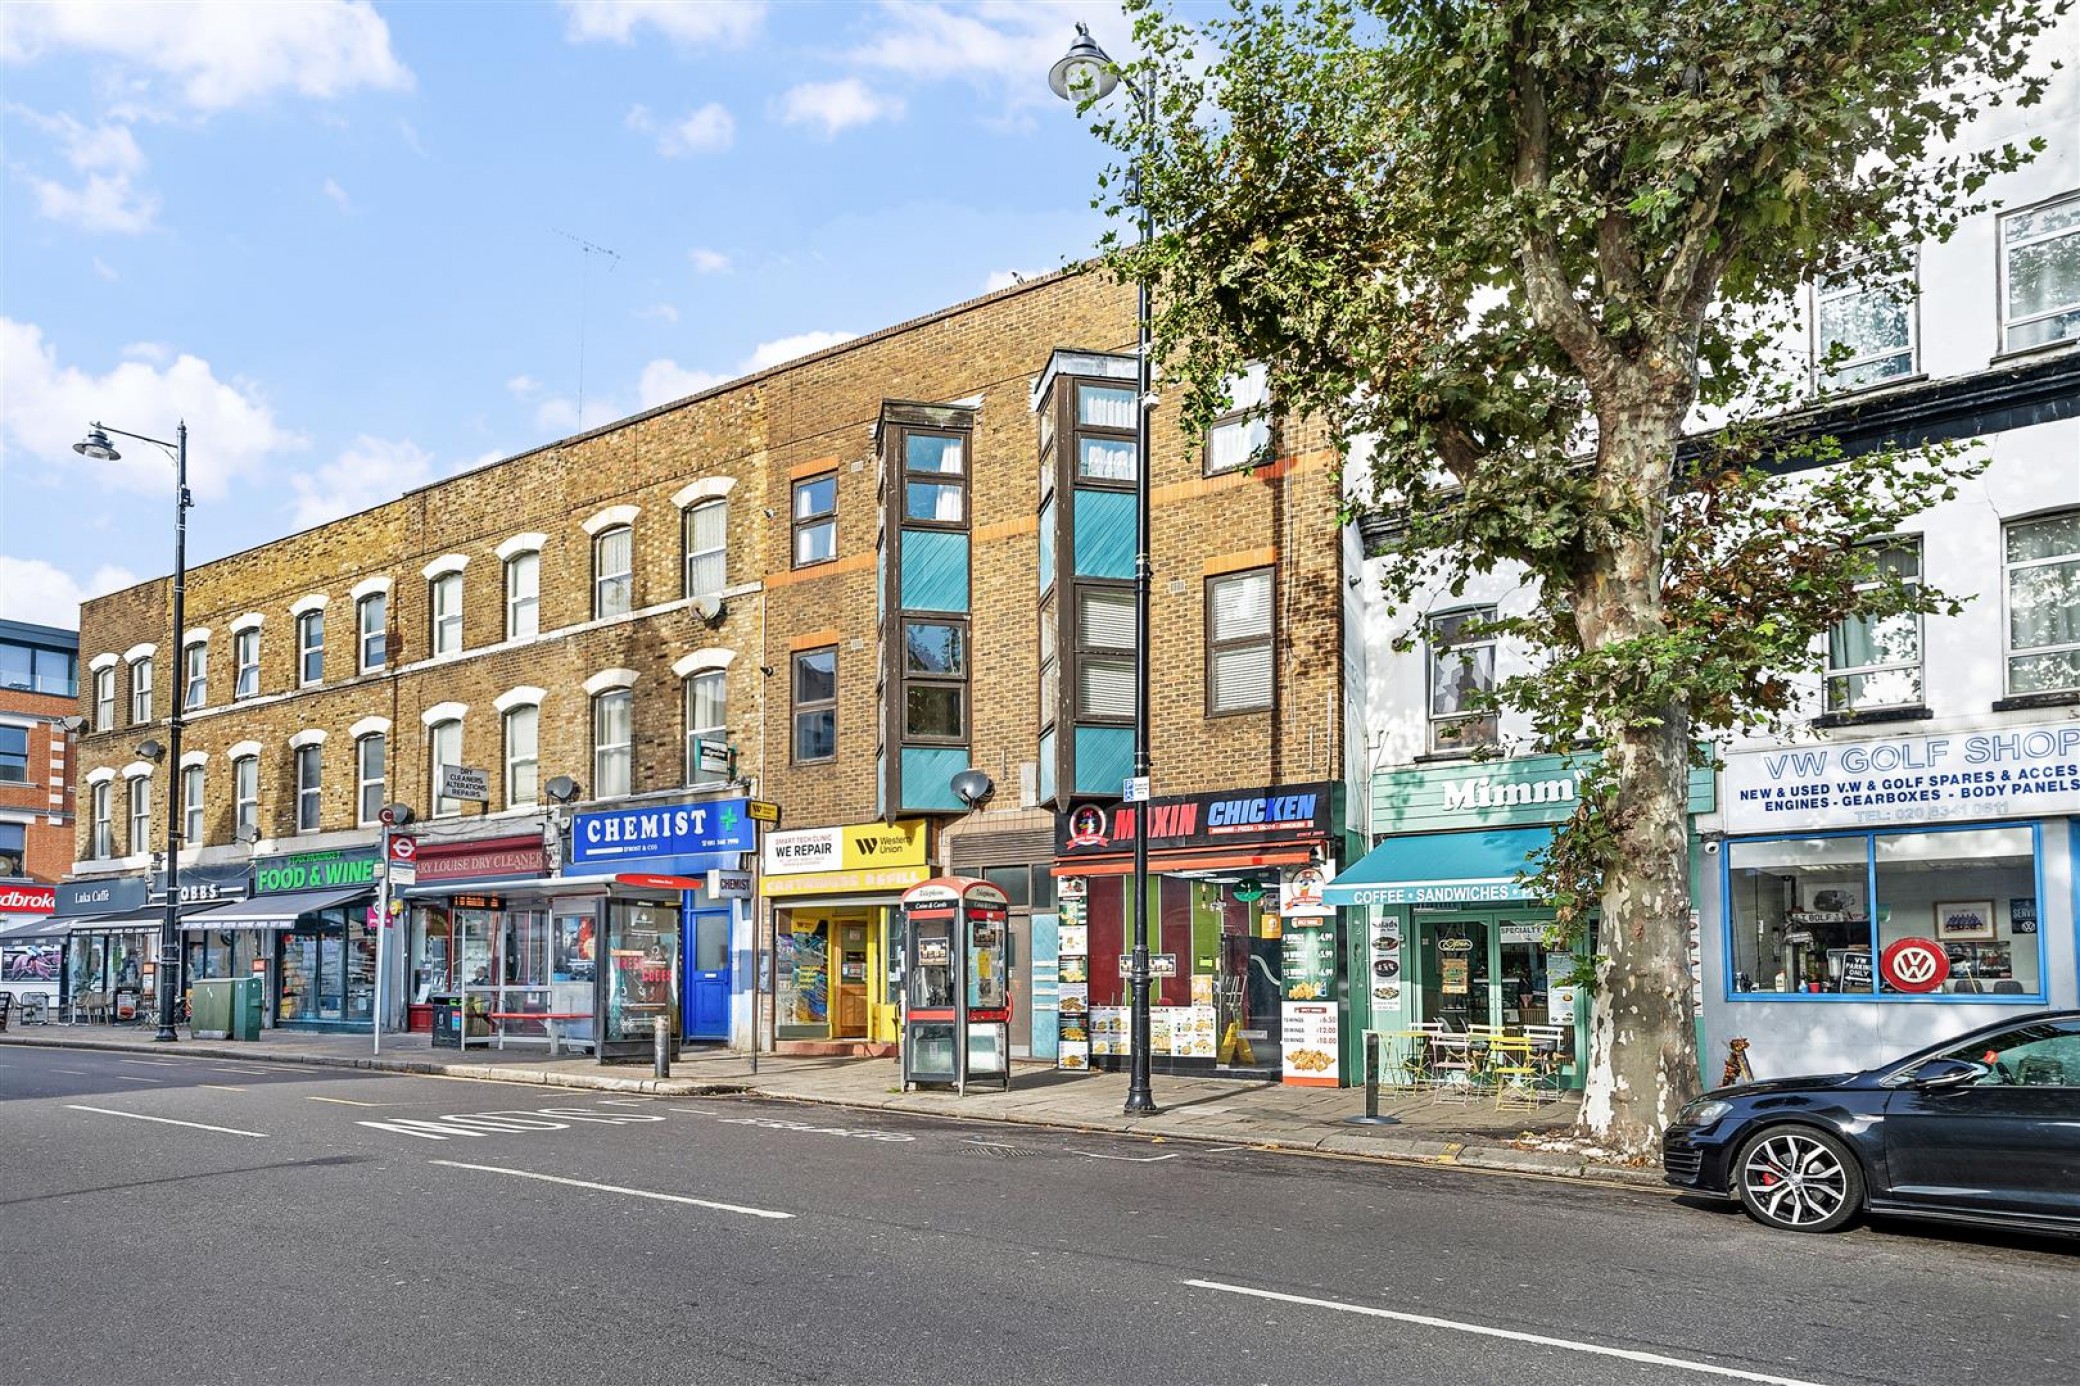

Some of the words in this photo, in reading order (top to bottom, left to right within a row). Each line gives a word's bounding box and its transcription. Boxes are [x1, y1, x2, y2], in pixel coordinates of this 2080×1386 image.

[1763, 751, 1828, 780] VW
[1841, 740, 1949, 774] GOLF
[1964, 728, 2080, 764] SHOP
[451, 773, 484, 784] CLEANERS
[1740, 787, 1772, 801] NEW
[1777, 787, 1785, 798] &
[1790, 783, 1830, 797] USED
[1837, 781, 1862, 794] V.W
[1866, 780, 1876, 791] &
[1882, 776, 1924, 789] GOLF
[1929, 770, 1995, 788] SPARES
[2001, 769, 2012, 782] &
[2018, 764, 2078, 780] ACCES
[447, 781, 487, 793] ALTERATIONS
[452, 788, 480, 797] REPAIRS
[1765, 797, 1829, 812] ENGINES
[1842, 789, 1941, 807] GEARBOXES
[1961, 784, 2006, 799] BODY
[2012, 778, 2080, 795] PANELS
[1113, 803, 1198, 841] MXIN
[1207, 794, 1316, 826] CHICKEN
[1854, 810, 1891, 823] TEL:
[587, 809, 706, 843] CHEMIST
[775, 837, 795, 846] SMART
[796, 836, 813, 844] TECH
[813, 834, 832, 842] CLINIC
[879, 836, 911, 846] Western
[776, 845, 792, 858] WE
[794, 843, 832, 857] REPAIR
[880, 845, 903, 854] Union
[434, 858, 470, 872] LOUISE
[471, 856, 491, 869] DRY
[258, 867, 306, 891] FOOD
[310, 865, 322, 887] &
[325, 859, 374, 885] WINE
[865, 871, 918, 886] REFILL
[720, 878, 750, 890] CHEMIST
[920, 890, 944, 898] Telephone
[1354, 889, 1404, 904] COFFEE
[1416, 885, 1508, 902] SANDWICHES
[1501, 927, 1541, 935] SPECIALTY
